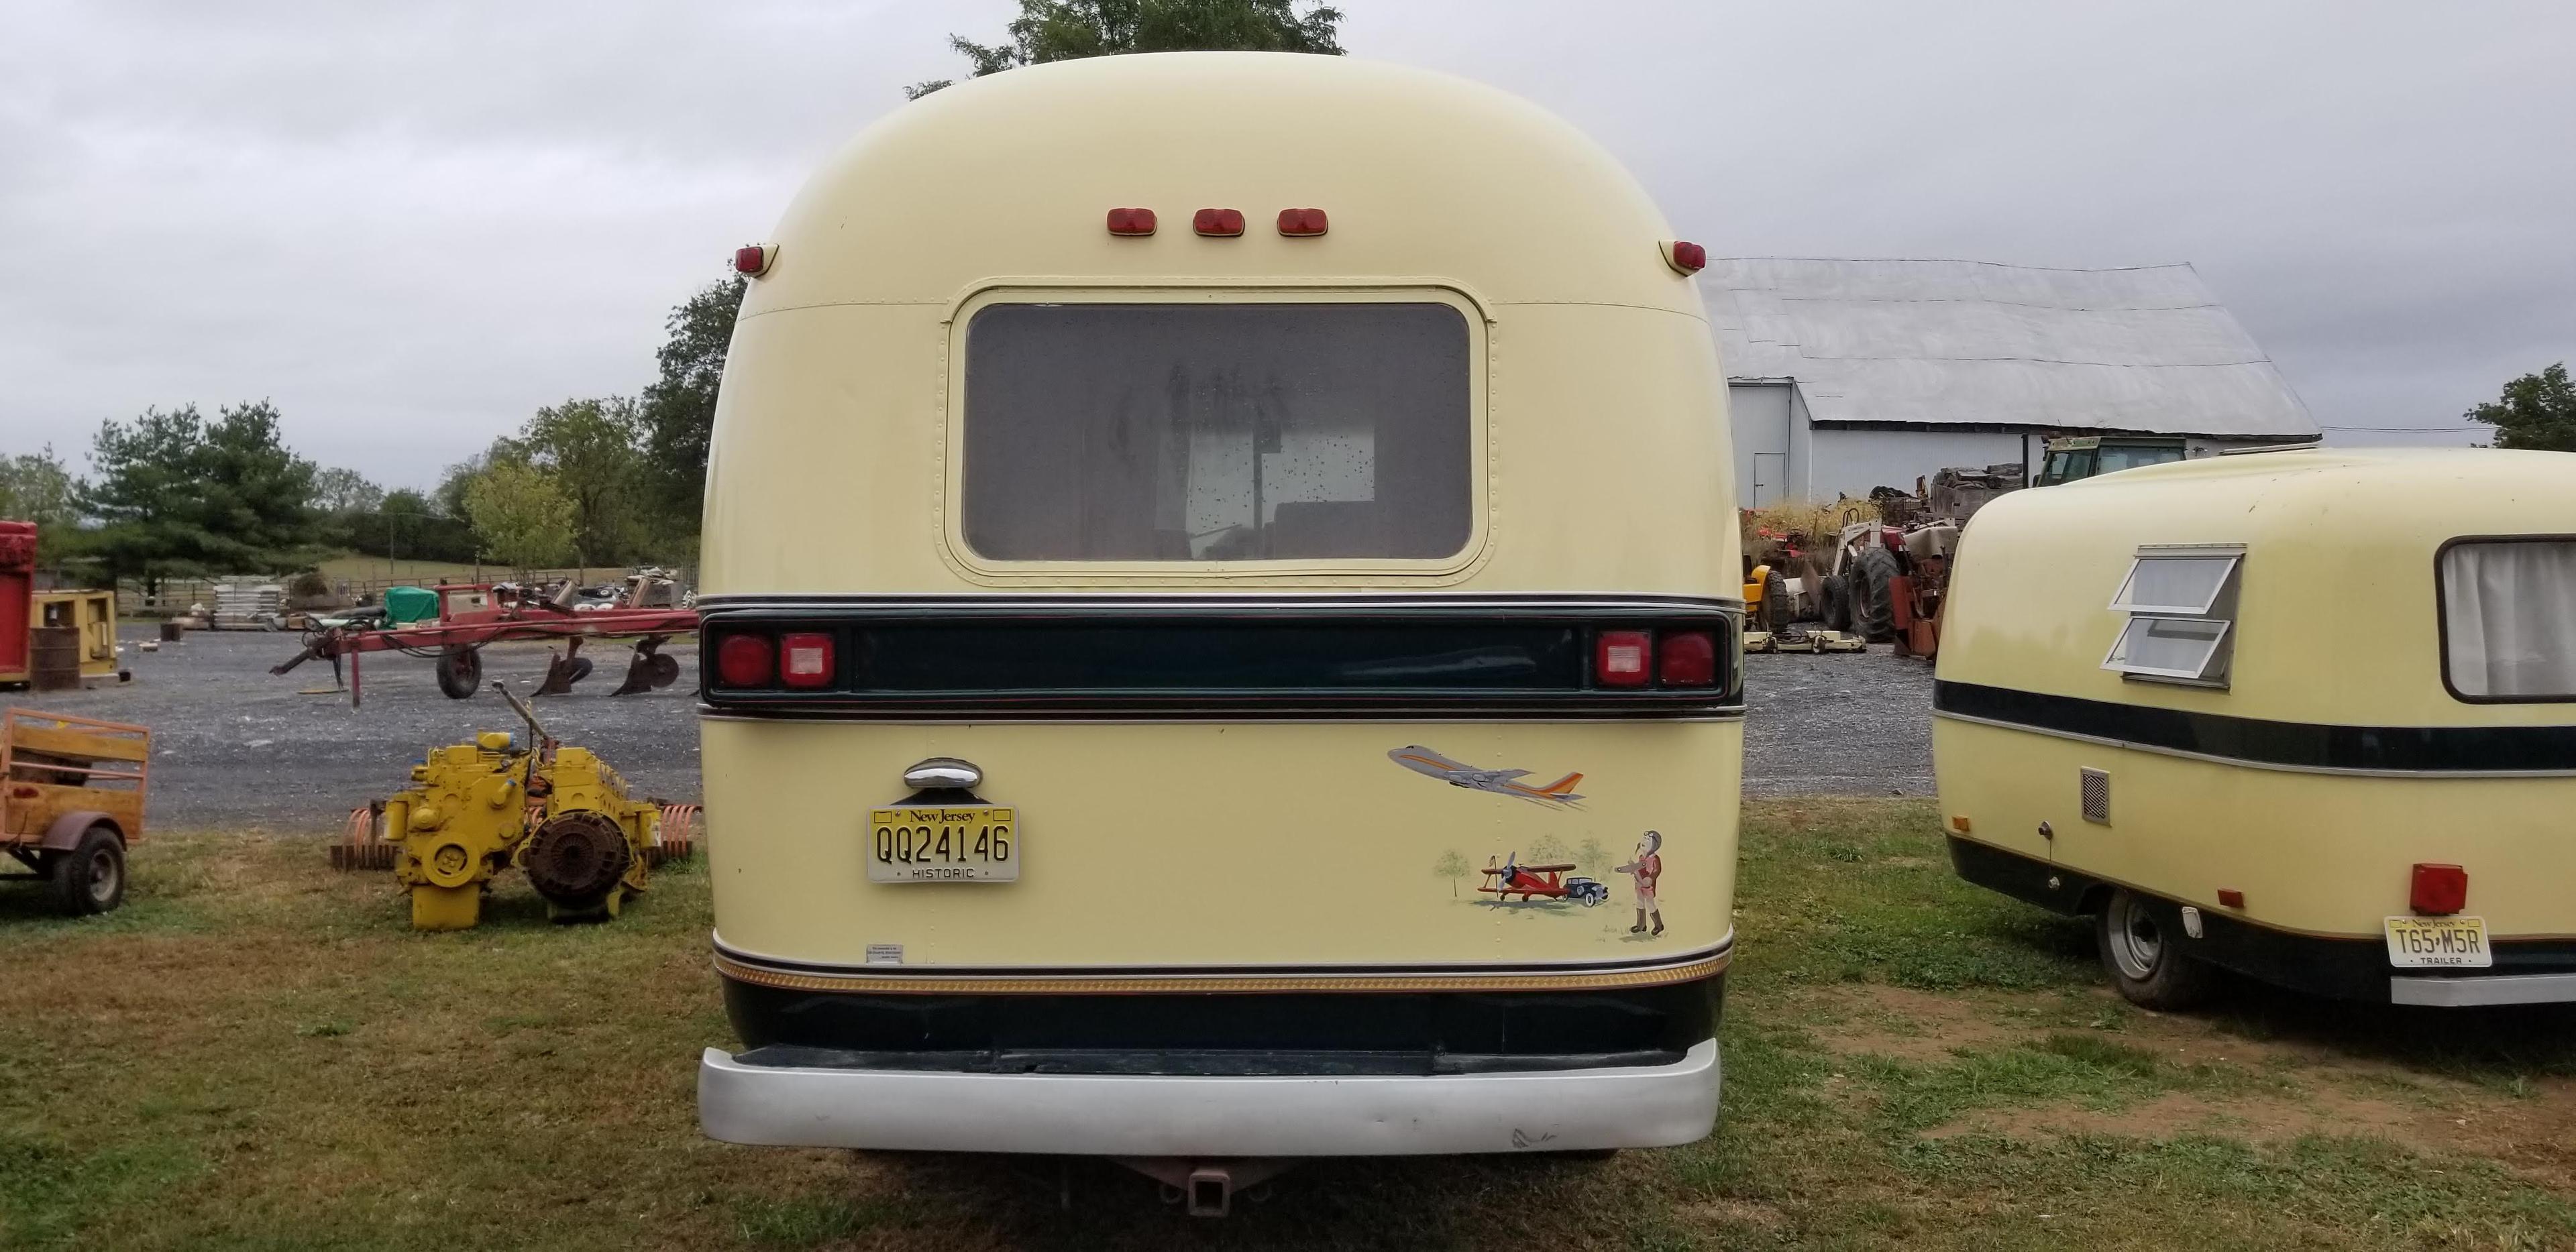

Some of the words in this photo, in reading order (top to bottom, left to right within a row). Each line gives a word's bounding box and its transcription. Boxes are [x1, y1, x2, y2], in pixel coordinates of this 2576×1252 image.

[910, 810, 938, 823] New
[939, 809, 976, 824] Jersey
[876, 826, 1009, 864] QQ24146
[912, 868, 975, 878] HISTORIC
[2412, 919, 2432, 927] New
